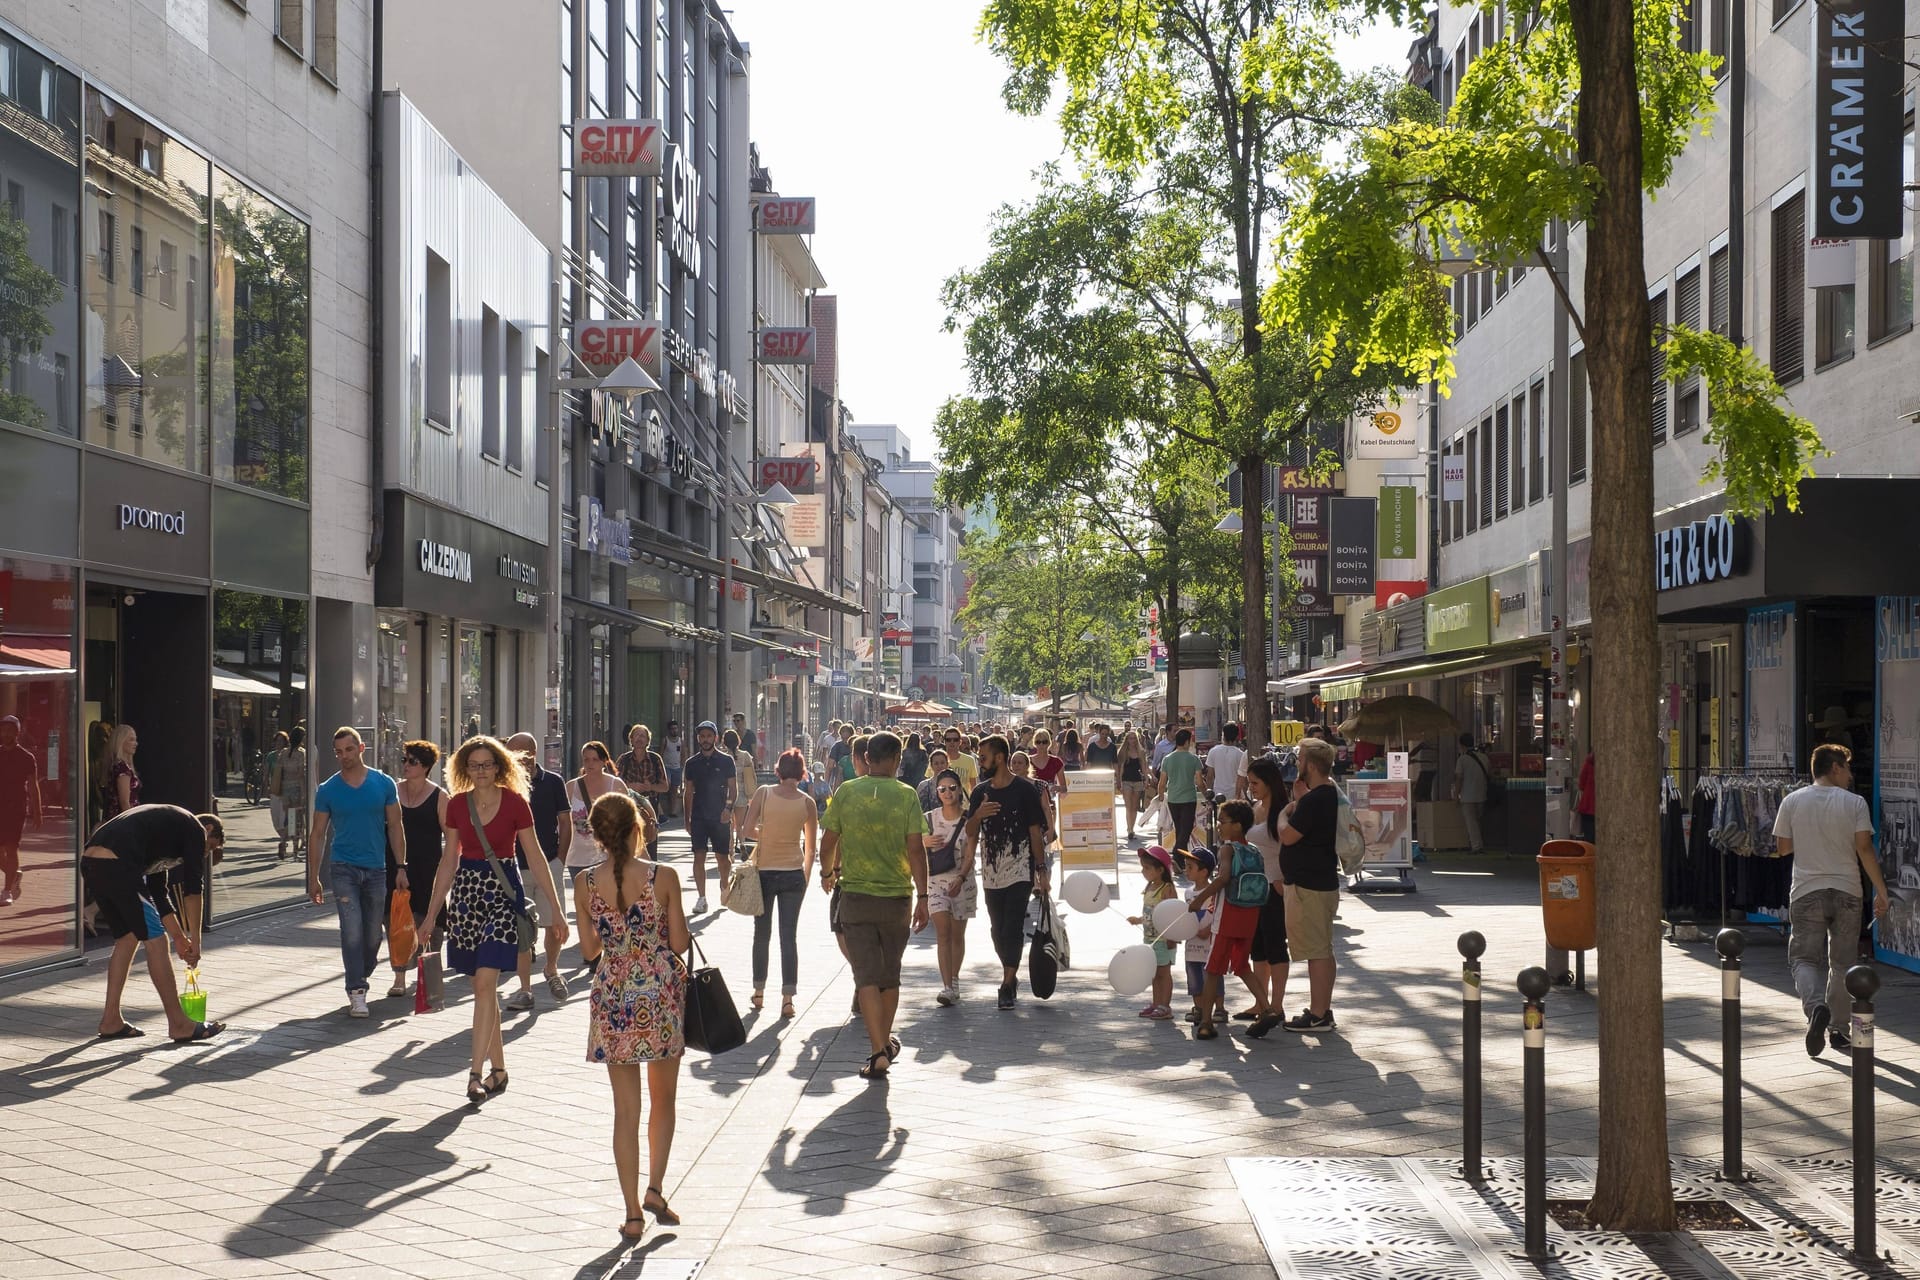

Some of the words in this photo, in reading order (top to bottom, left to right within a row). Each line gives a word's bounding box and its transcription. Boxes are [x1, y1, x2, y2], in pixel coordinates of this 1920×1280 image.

[1829, 10, 1865, 225] CRÄMER
[581, 126, 657, 164] CITY
[581, 152, 628, 164] POINT
[763, 201, 811, 226] CITY
[763, 218, 793, 227] POINT
[581, 326, 657, 360] CITY
[763, 331, 812, 357] CITY
[763, 348, 793, 357] POINT
[581, 352, 628, 365] POINT
[762, 462, 811, 487] CITY
[1283, 467, 1331, 489] ASIA
[121, 503, 185, 535] promod
[421, 539, 472, 583] CALZEDONIA
[1336, 545, 1368, 556] BONITA
[1336, 560, 1368, 571] BONITA
[1336, 575, 1368, 586] BONITA
[1746, 609, 1783, 671] SALE!
